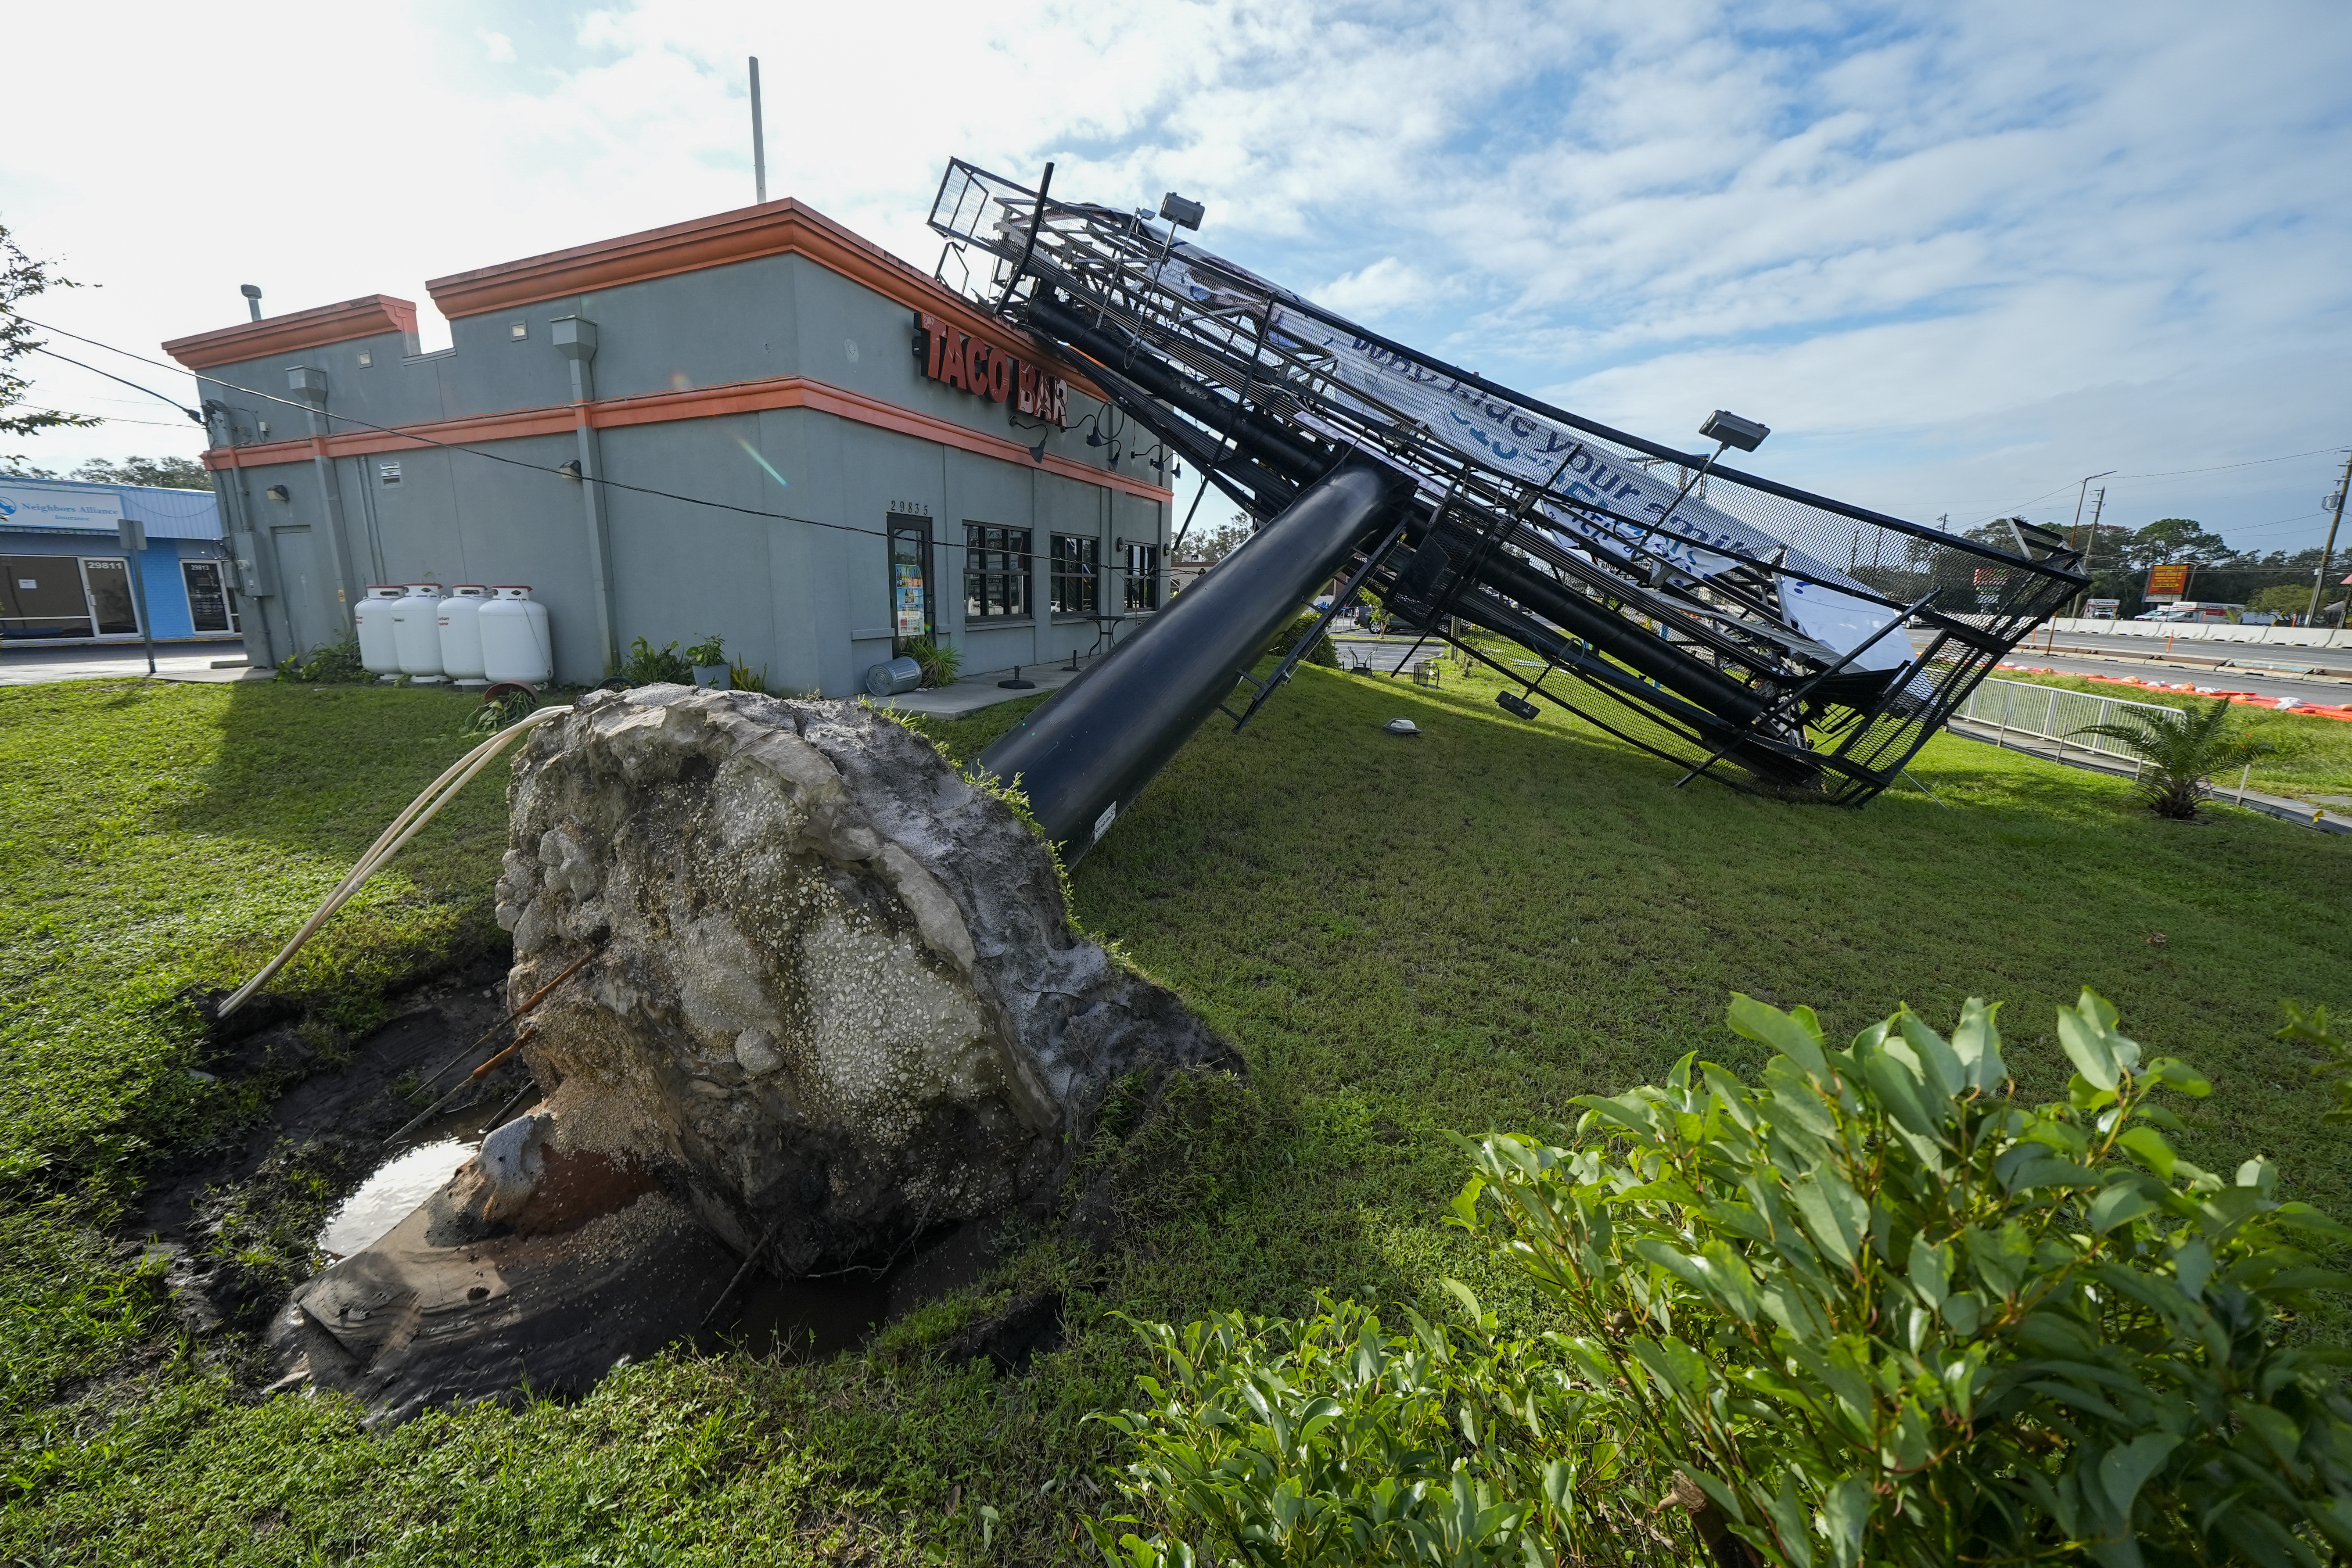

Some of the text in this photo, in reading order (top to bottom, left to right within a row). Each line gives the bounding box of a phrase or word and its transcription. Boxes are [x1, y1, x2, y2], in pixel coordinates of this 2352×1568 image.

[915, 312, 1068, 427] TACO BAR
[1535, 431, 1641, 499] your
[22, 503, 118, 515] Neighbors Alliance
[891, 500, 928, 515] 29835
